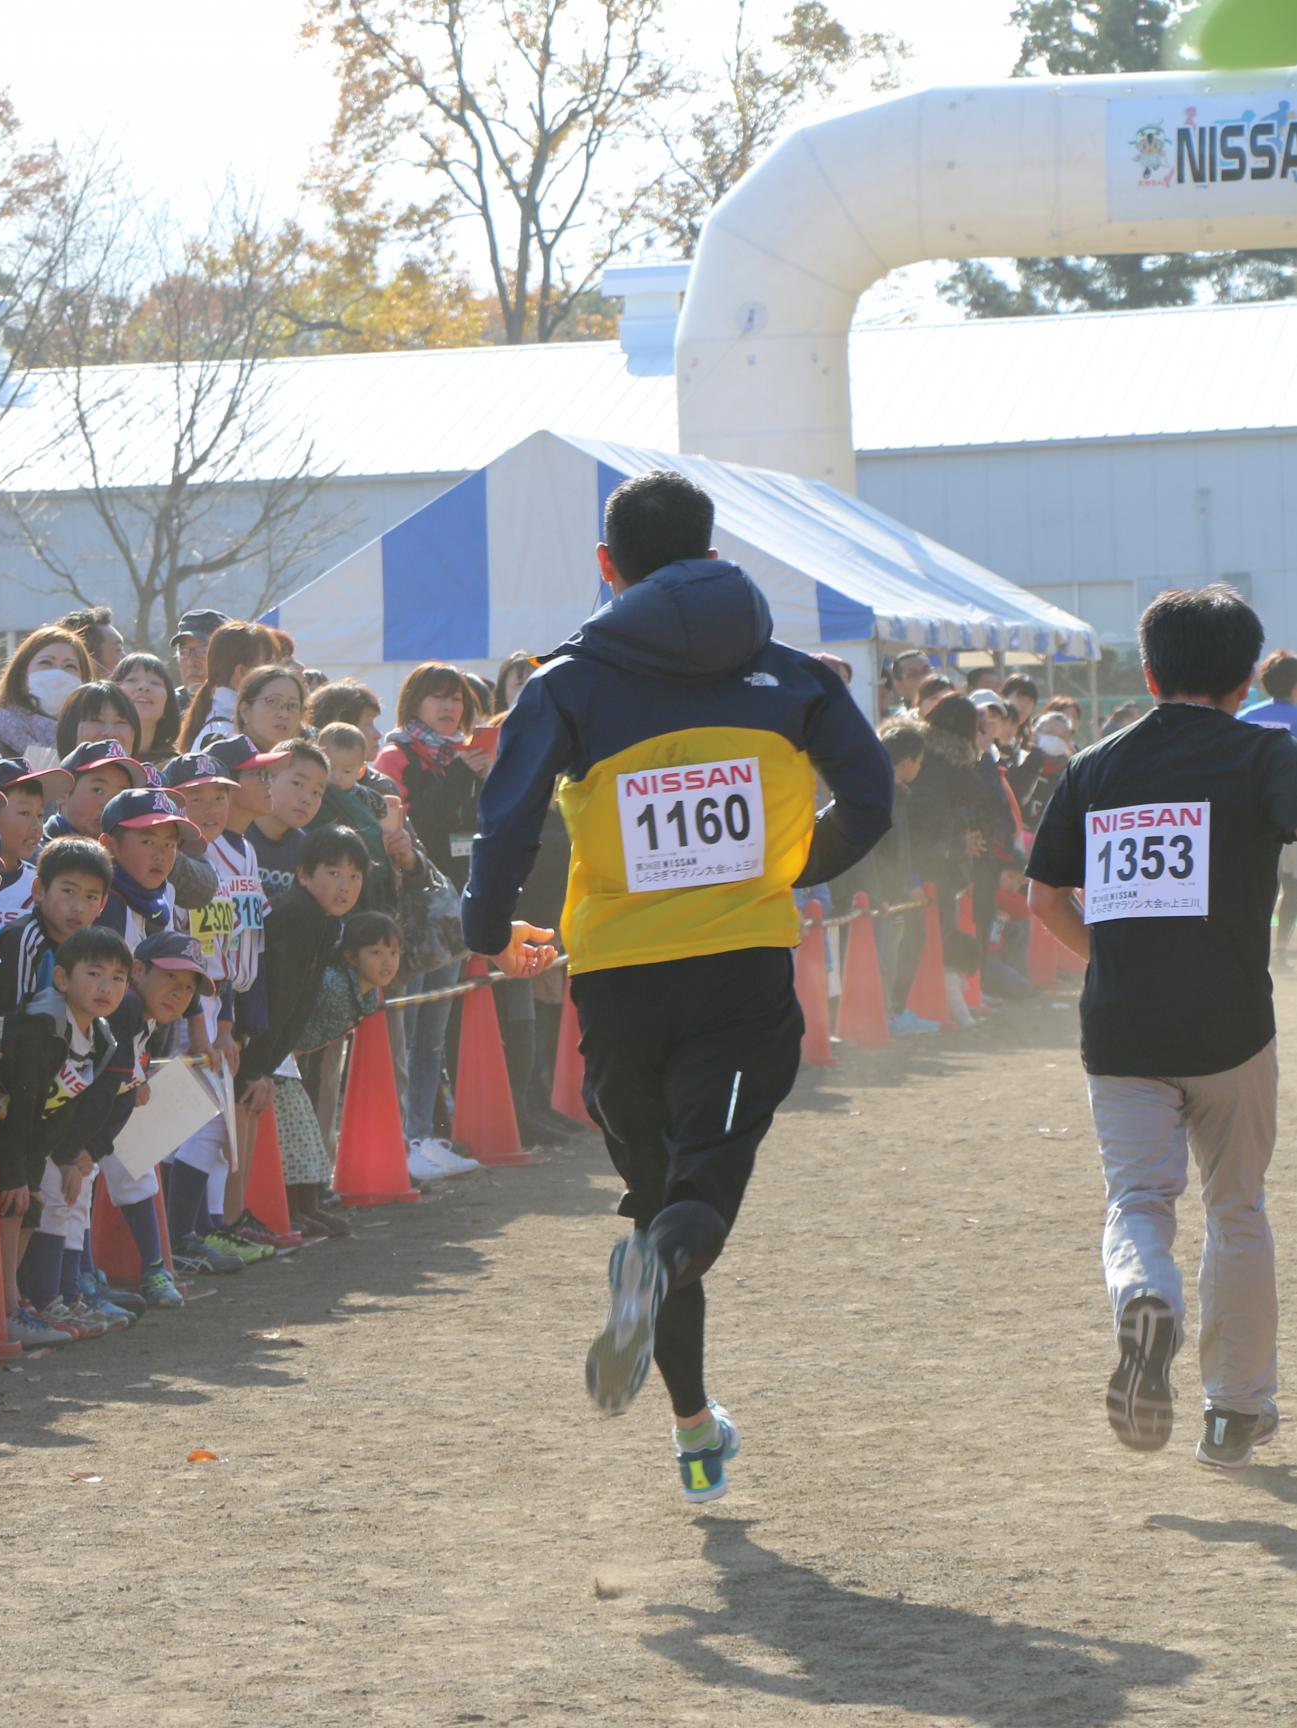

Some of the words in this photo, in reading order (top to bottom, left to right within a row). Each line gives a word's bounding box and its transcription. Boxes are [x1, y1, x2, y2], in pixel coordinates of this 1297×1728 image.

[626, 764, 752, 797] NISSAN
[636, 793, 750, 850] 1160
[1092, 808, 1201, 835] NISSAN
[663, 857, 698, 868] NISSAN
[1098, 834, 1194, 884] 1353
[1110, 890, 1138, 900] NISSAN
